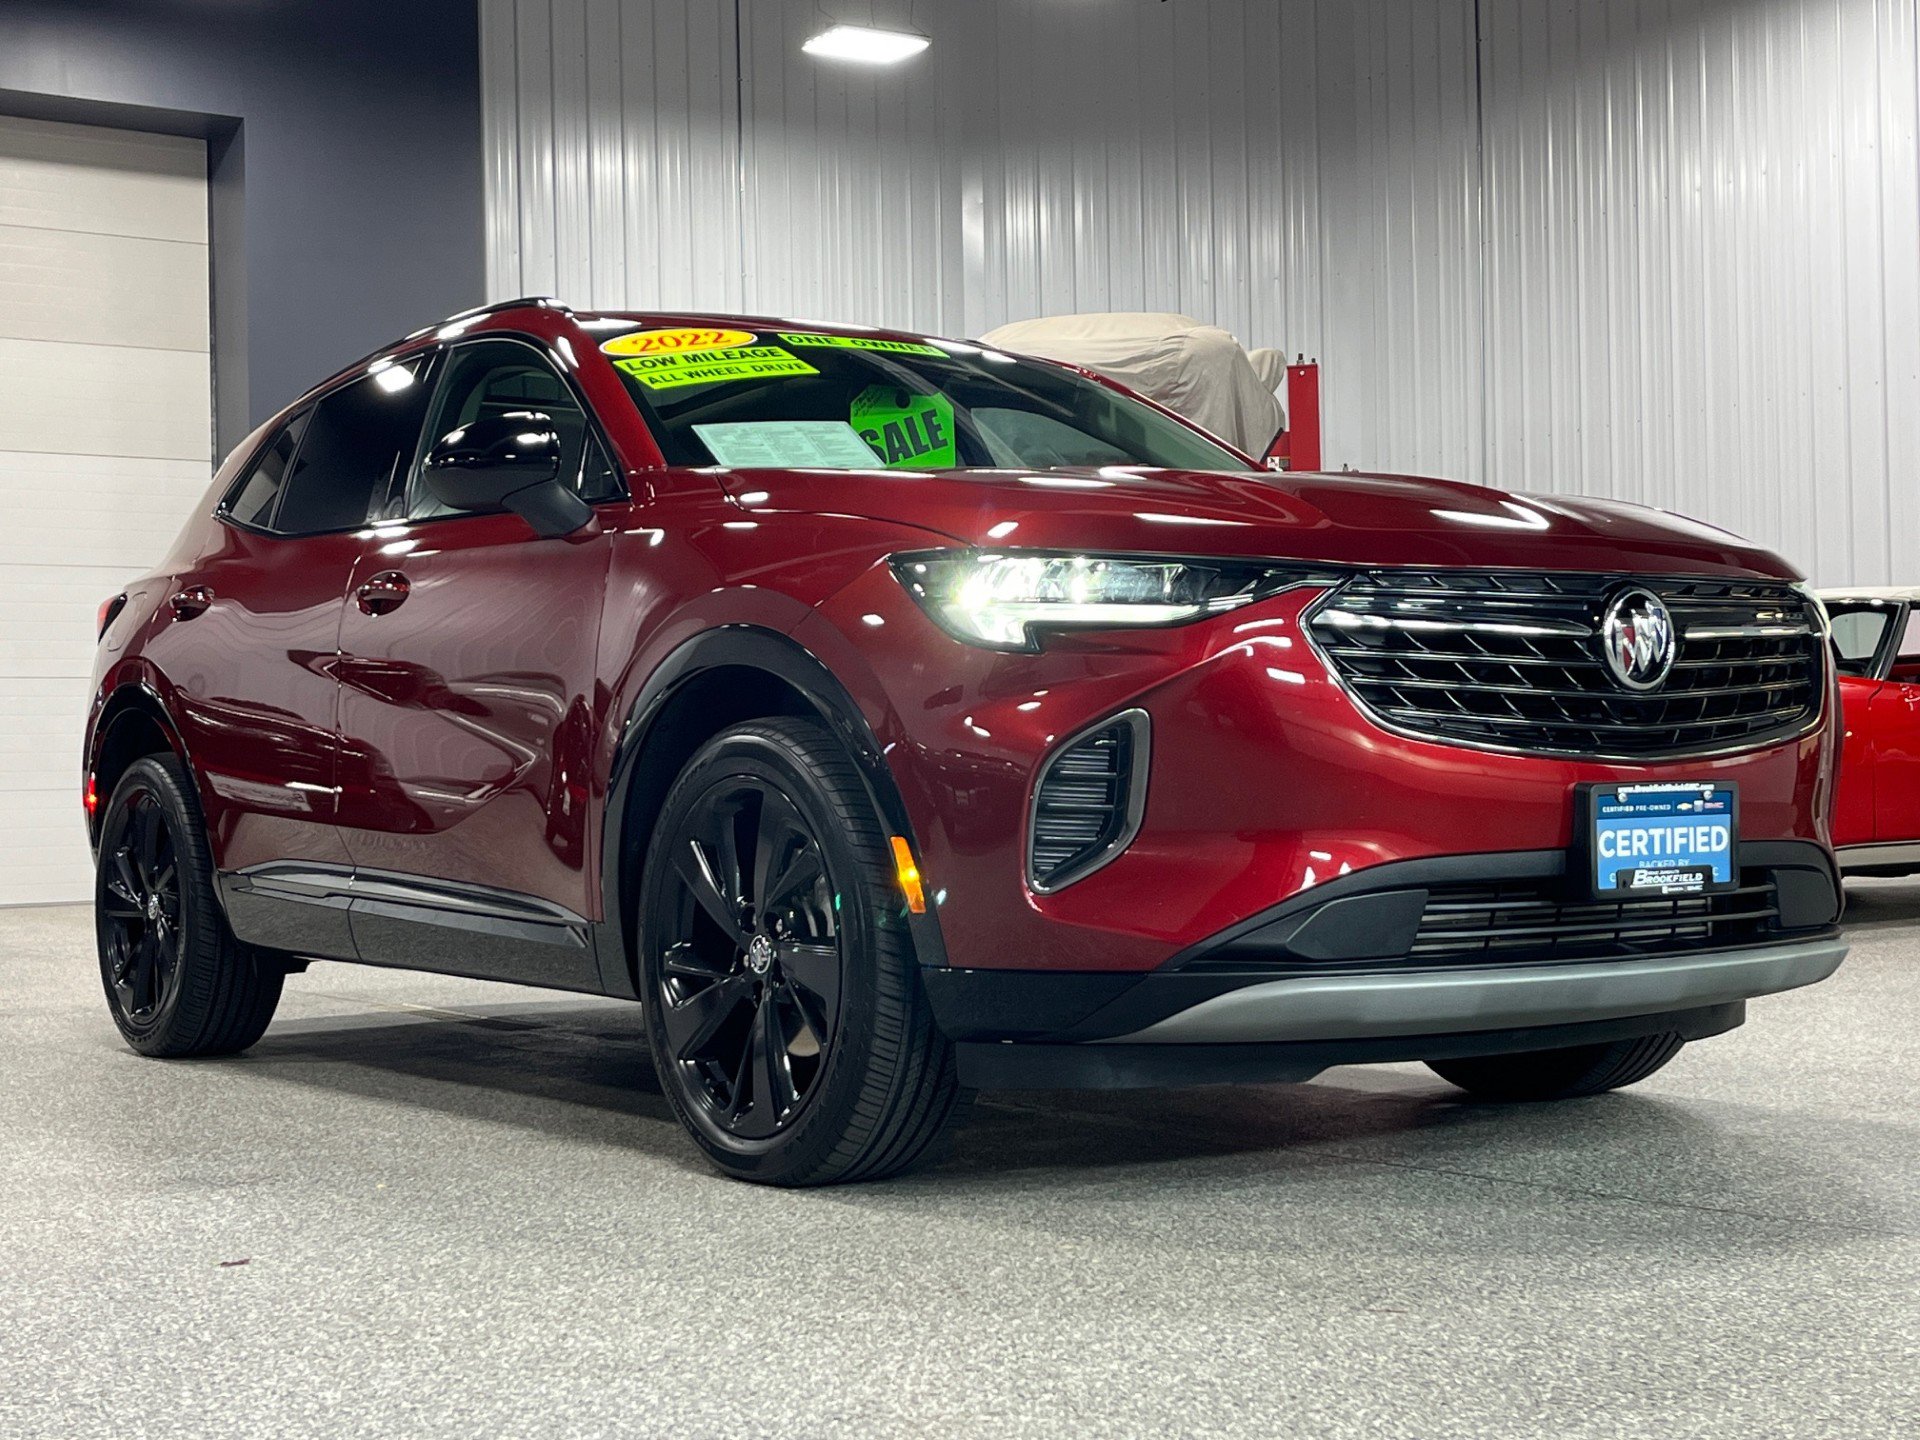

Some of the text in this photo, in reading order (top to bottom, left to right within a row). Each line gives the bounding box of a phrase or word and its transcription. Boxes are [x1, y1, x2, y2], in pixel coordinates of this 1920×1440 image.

[632, 331, 731, 352] 2022
[787, 335, 938, 354] ONE OWNER
[625, 348, 784, 370] LOW MILEAGE
[648, 361, 808, 386] ALL WHEEL DRIVE
[859, 408, 949, 465] SALE
[1602, 804, 1671, 813] CERTIFIED PRE-OWNED
[1598, 825, 1729, 858] CERTIFIED
[1639, 860, 1676, 868] BACKED
[1633, 869, 1704, 885] BROOKFIELD
